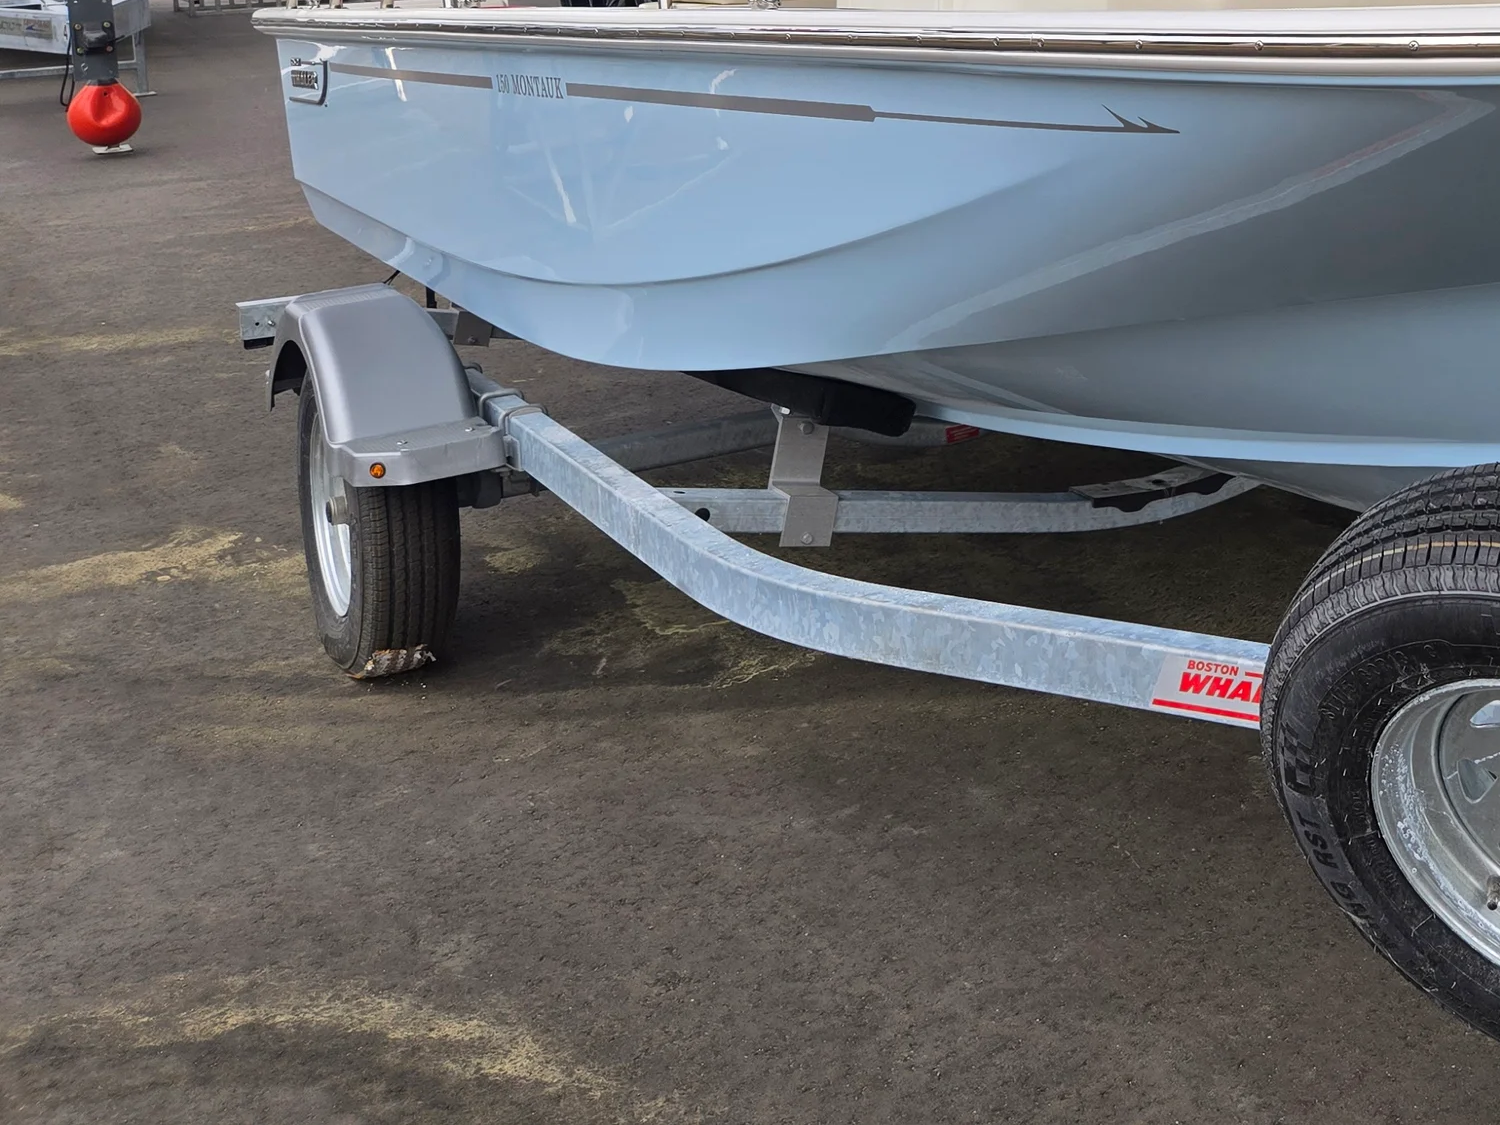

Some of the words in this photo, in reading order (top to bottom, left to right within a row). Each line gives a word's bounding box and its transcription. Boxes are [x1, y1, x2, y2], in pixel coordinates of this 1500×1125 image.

[496, 73, 510, 94] 150
[510, 74, 564, 99] MONTAUK
[1187, 659, 1239, 676] BOSTON
